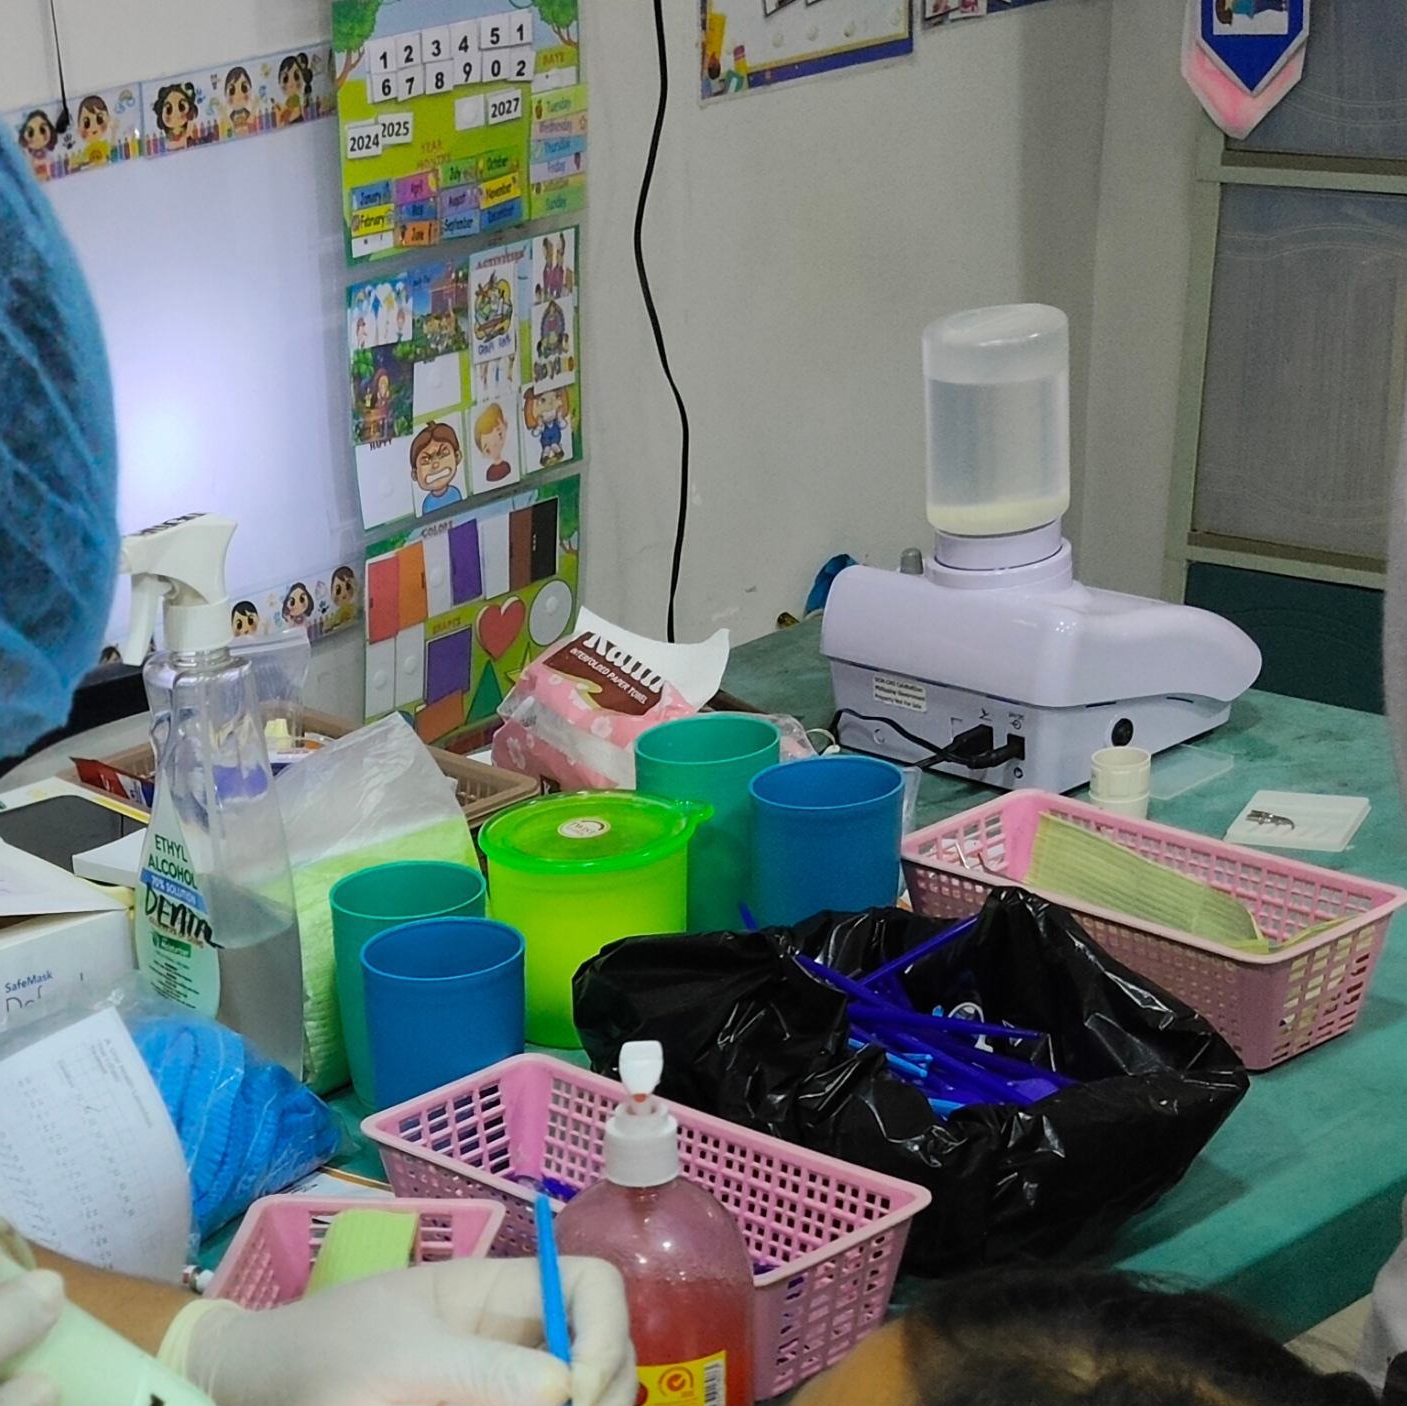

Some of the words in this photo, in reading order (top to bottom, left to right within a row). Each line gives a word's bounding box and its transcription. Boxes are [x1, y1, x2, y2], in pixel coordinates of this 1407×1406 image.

[379, 51, 389, 69] 1
[404, 45, 414, 64] 2
[431, 39, 442, 57] 3
[458, 35, 469, 54] 4
[490, 27, 500, 45] 5
[516, 23, 524, 41] 1
[381, 78, 392, 97] 6
[405, 76, 415, 95] 7
[434, 72, 445, 90] 8
[462, 62, 473, 82] 9
[490, 59, 501, 77] 0
[515, 60, 526, 77] 2
[490, 97, 521, 119] 2027
[380, 120, 410, 138] 2025
[349, 132, 381, 152] 2024
[606, 669, 631, 692] PAPER
[154, 833, 188, 863] ETHYL
[147, 853, 199, 890] ALCOHOL
[4, 969, 53, 994] SafeMask
